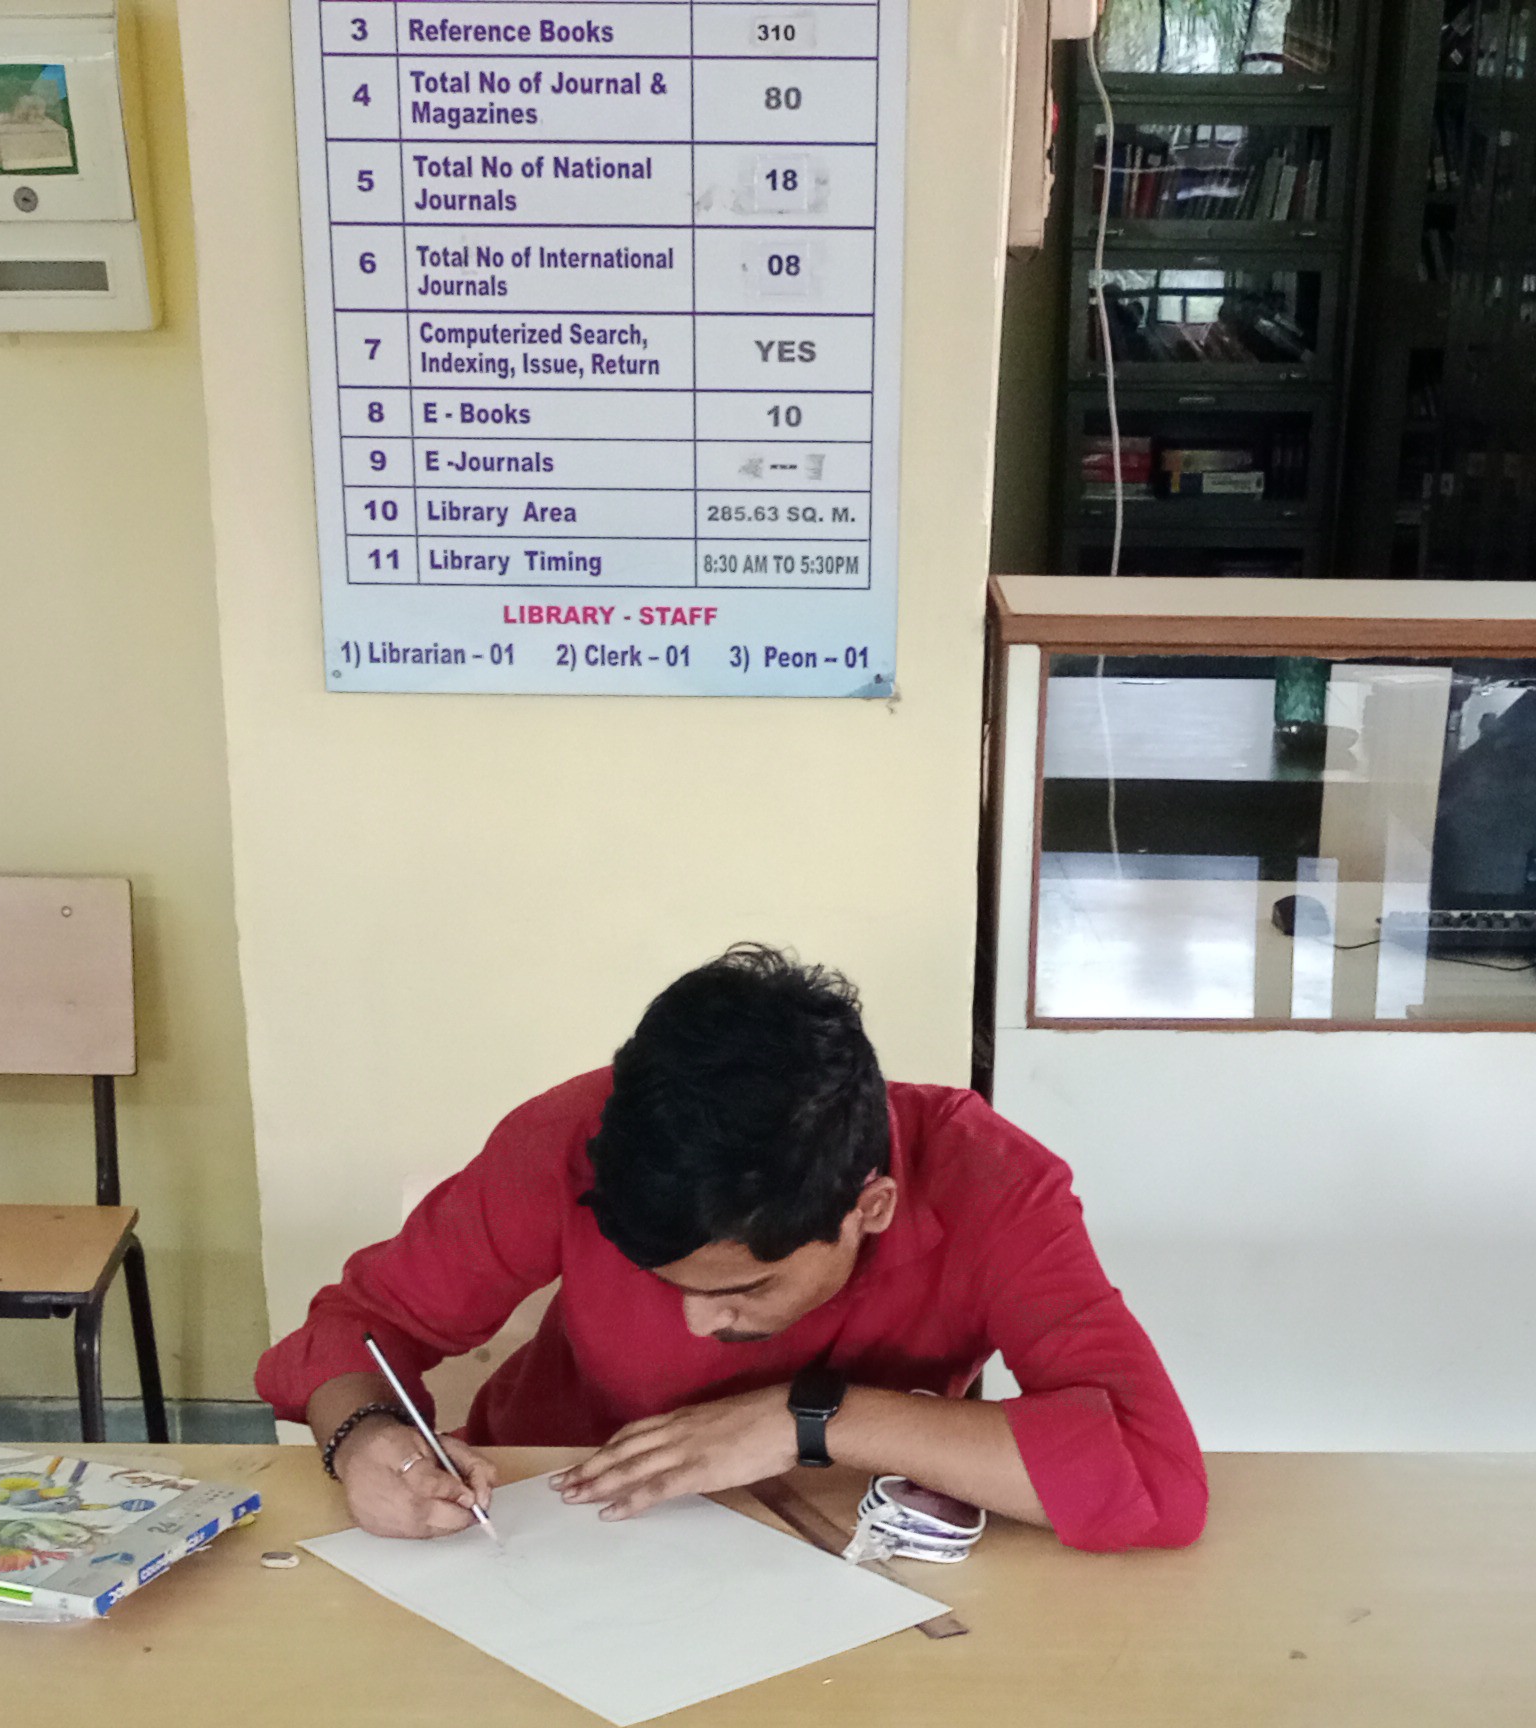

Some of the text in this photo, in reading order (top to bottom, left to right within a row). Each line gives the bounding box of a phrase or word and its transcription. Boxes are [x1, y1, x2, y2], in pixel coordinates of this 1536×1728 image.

[351, 18, 368, 41] 3
[409, 19, 613, 42] Reference Books
[758, 24, 795, 41] 310
[410, 71, 667, 95] Total No of Journal &
[353, 84, 371, 106] 4
[765, 87, 802, 110] 80
[412, 101, 537, 129] Magazines
[413, 155, 651, 179] Total No of National
[357, 170, 374, 192] 5
[766, 169, 798, 191] 18
[415, 188, 517, 211] Journals
[359, 252, 376, 274] 6
[416, 246, 673, 269] Total No of International
[768, 255, 800, 276] 08
[418, 274, 507, 296] Journals
[420, 322, 647, 349] Computerized Search,
[364, 339, 381, 360] 7
[755, 341, 816, 363] YES
[421, 352, 659, 379] Indexing, Issue, Return
[368, 402, 384, 423] 8
[424, 402, 437, 423] E
[460, 403, 530, 424] Books
[767, 406, 802, 427] 10
[370, 450, 386, 471] 9
[426, 451, 439, 471] E
[364, 500, 398, 521] 10
[428, 501, 576, 527] Library Area
[707, 506, 855, 523] 285.63 SQ. M.
[369, 549, 399, 569] 11
[430, 550, 601, 577] Library Timing
[704, 554, 858, 574] 8:30 AM TO 5:30PM
[504, 605, 615, 625] LIBRARY
[639, 607, 717, 625] STAFF
[341, 641, 360, 668] 1)
[369, 642, 465, 664] Librarian
[490, 643, 513, 665] 01
[557, 644, 576, 671] 2)
[585, 644, 642, 666] Clerk
[666, 645, 689, 667] 01
[730, 646, 749, 673] 3)
[765, 646, 817, 668] Peon
[845, 646, 867, 668] 01
